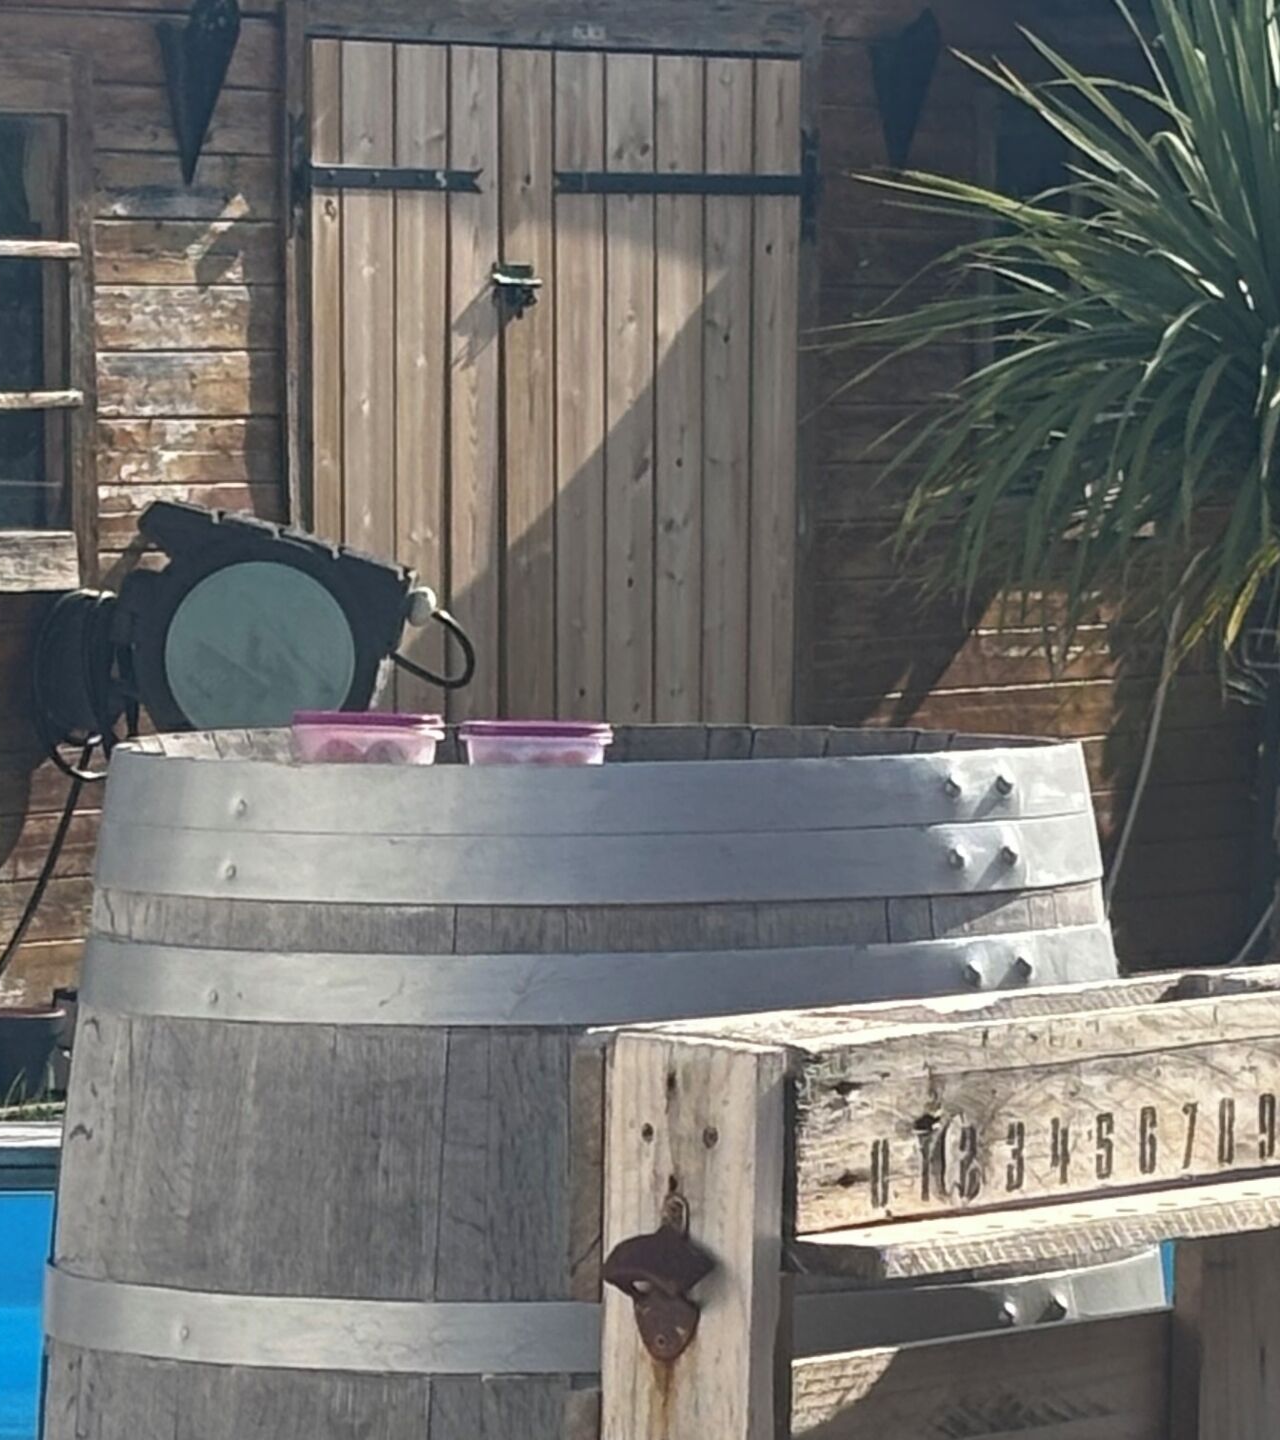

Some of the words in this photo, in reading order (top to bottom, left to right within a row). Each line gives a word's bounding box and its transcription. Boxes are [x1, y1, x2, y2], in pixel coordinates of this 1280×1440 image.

[1005, 1120, 1025, 1192] 3
[1050, 1117, 1070, 1185] 4
[1095, 1112, 1114, 1180] 5
[1139, 1106, 1157, 1174] 6
[1181, 1101, 1199, 1170] 7
[1258, 1093, 1276, 1160] 9
